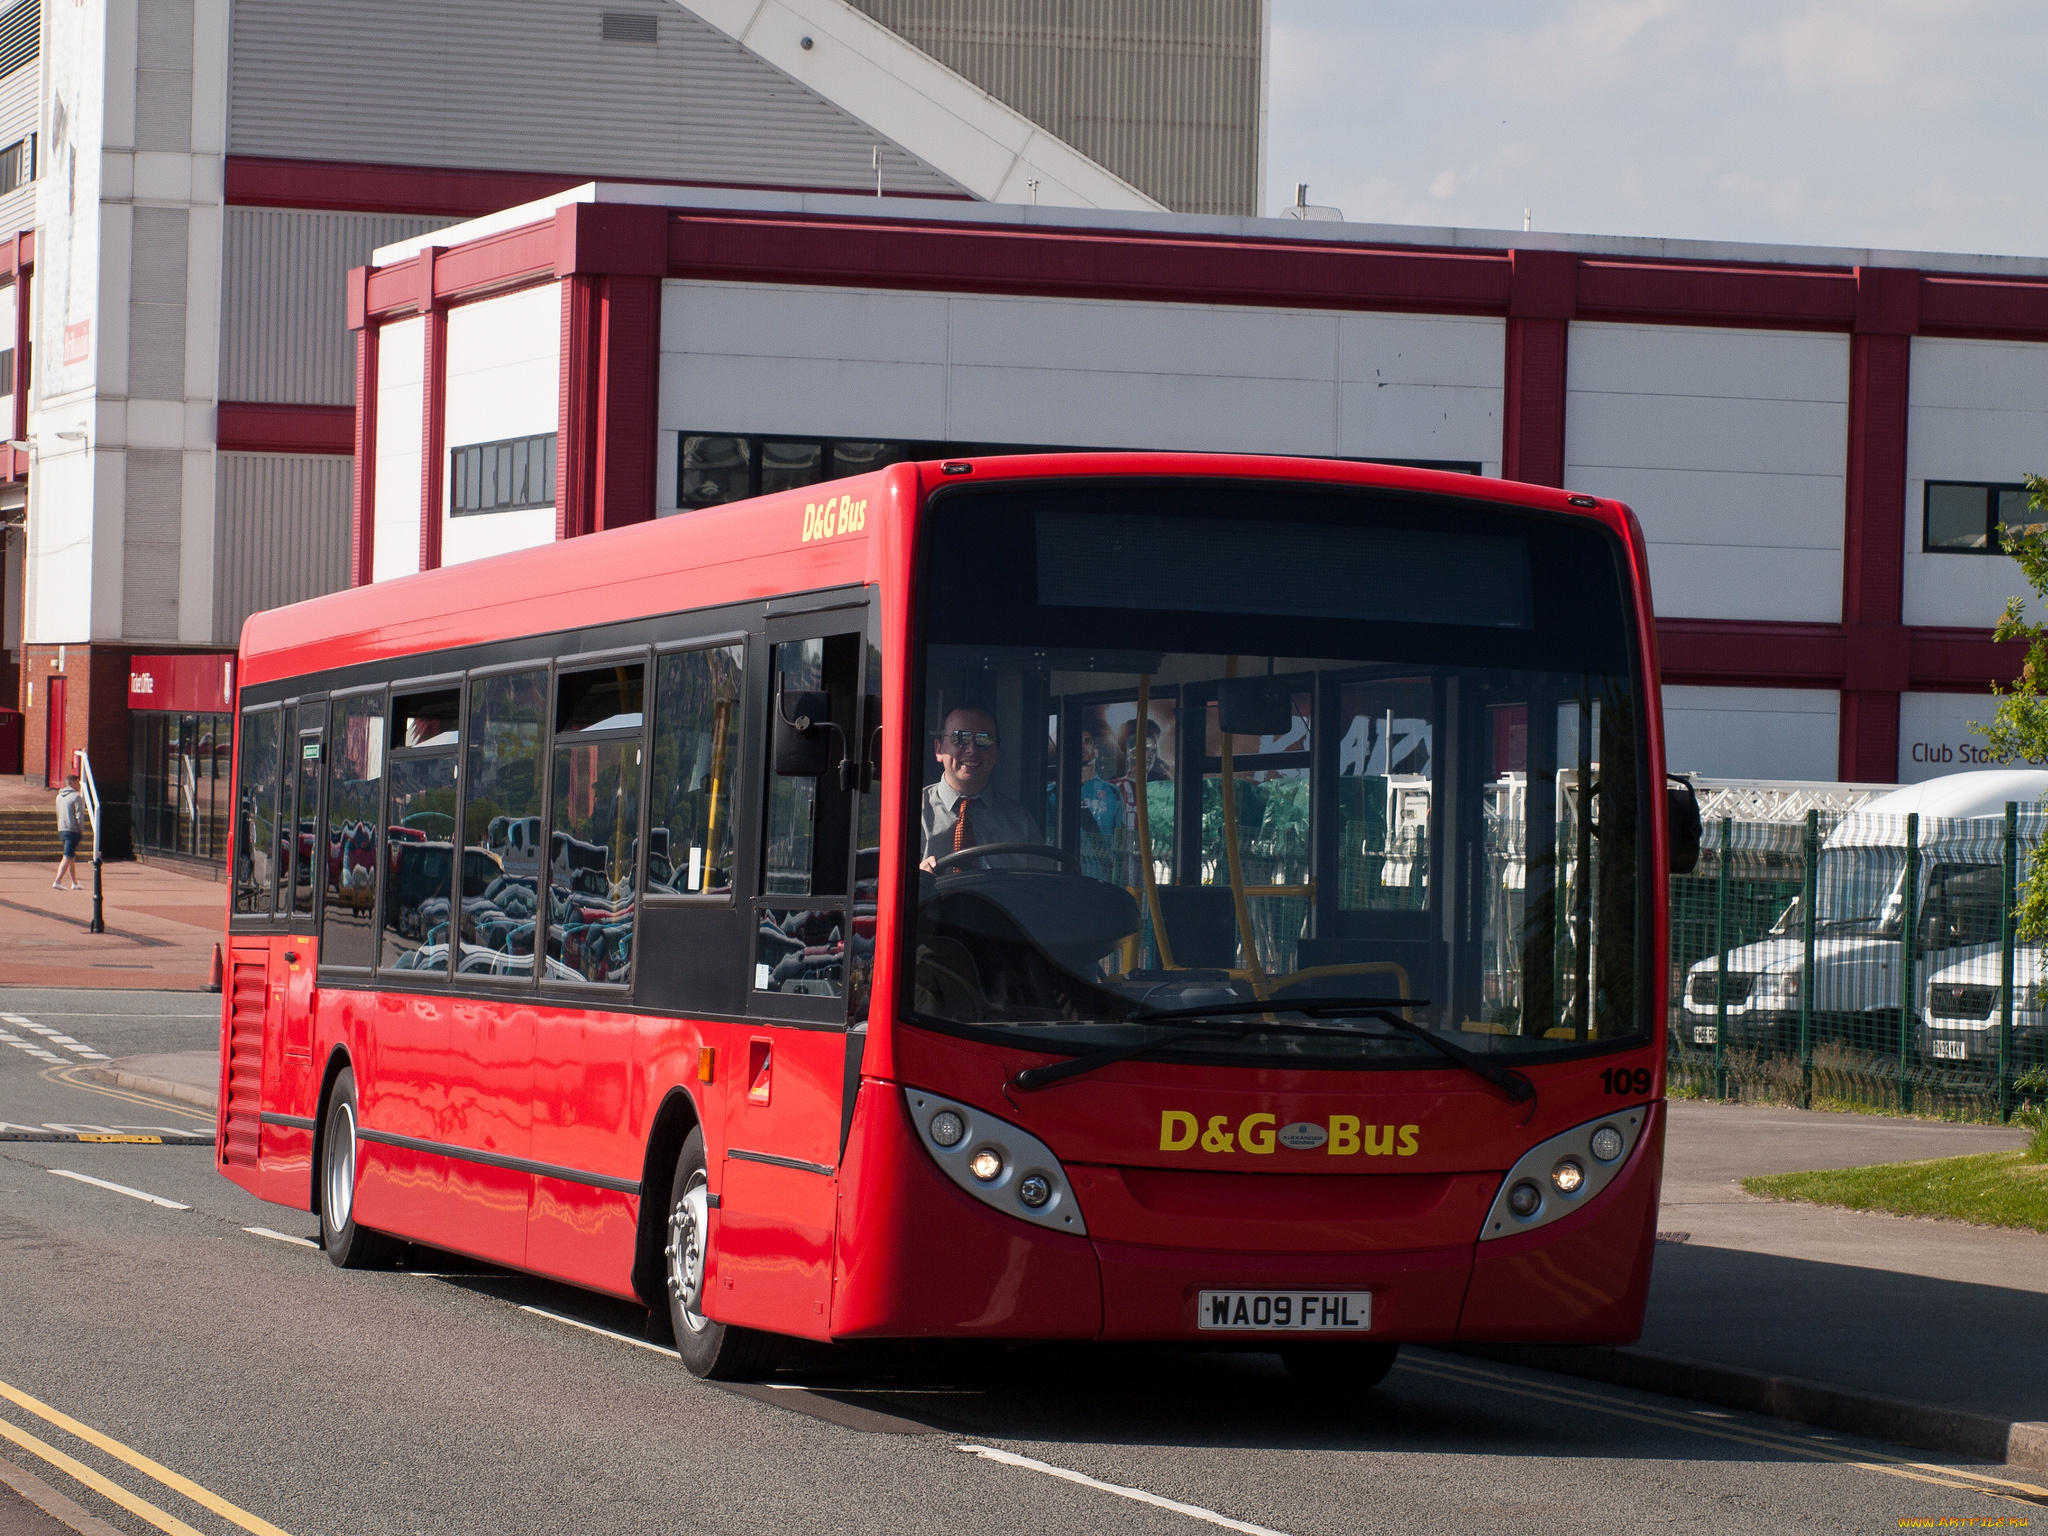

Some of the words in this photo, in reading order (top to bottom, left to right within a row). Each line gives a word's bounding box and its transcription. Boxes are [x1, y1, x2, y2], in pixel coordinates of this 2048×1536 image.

[802, 498, 837, 542] D&G
[837, 495, 867, 535] Bus
[1912, 742, 1953, 763] Club
[1600, 1067, 1651, 1095] 109
[1159, 1111, 1276, 1154] D&G
[1327, 1115, 1419, 1156] Bus
[1212, 1296, 1292, 1325] WA09
[1301, 1297, 1359, 1326] FHL
